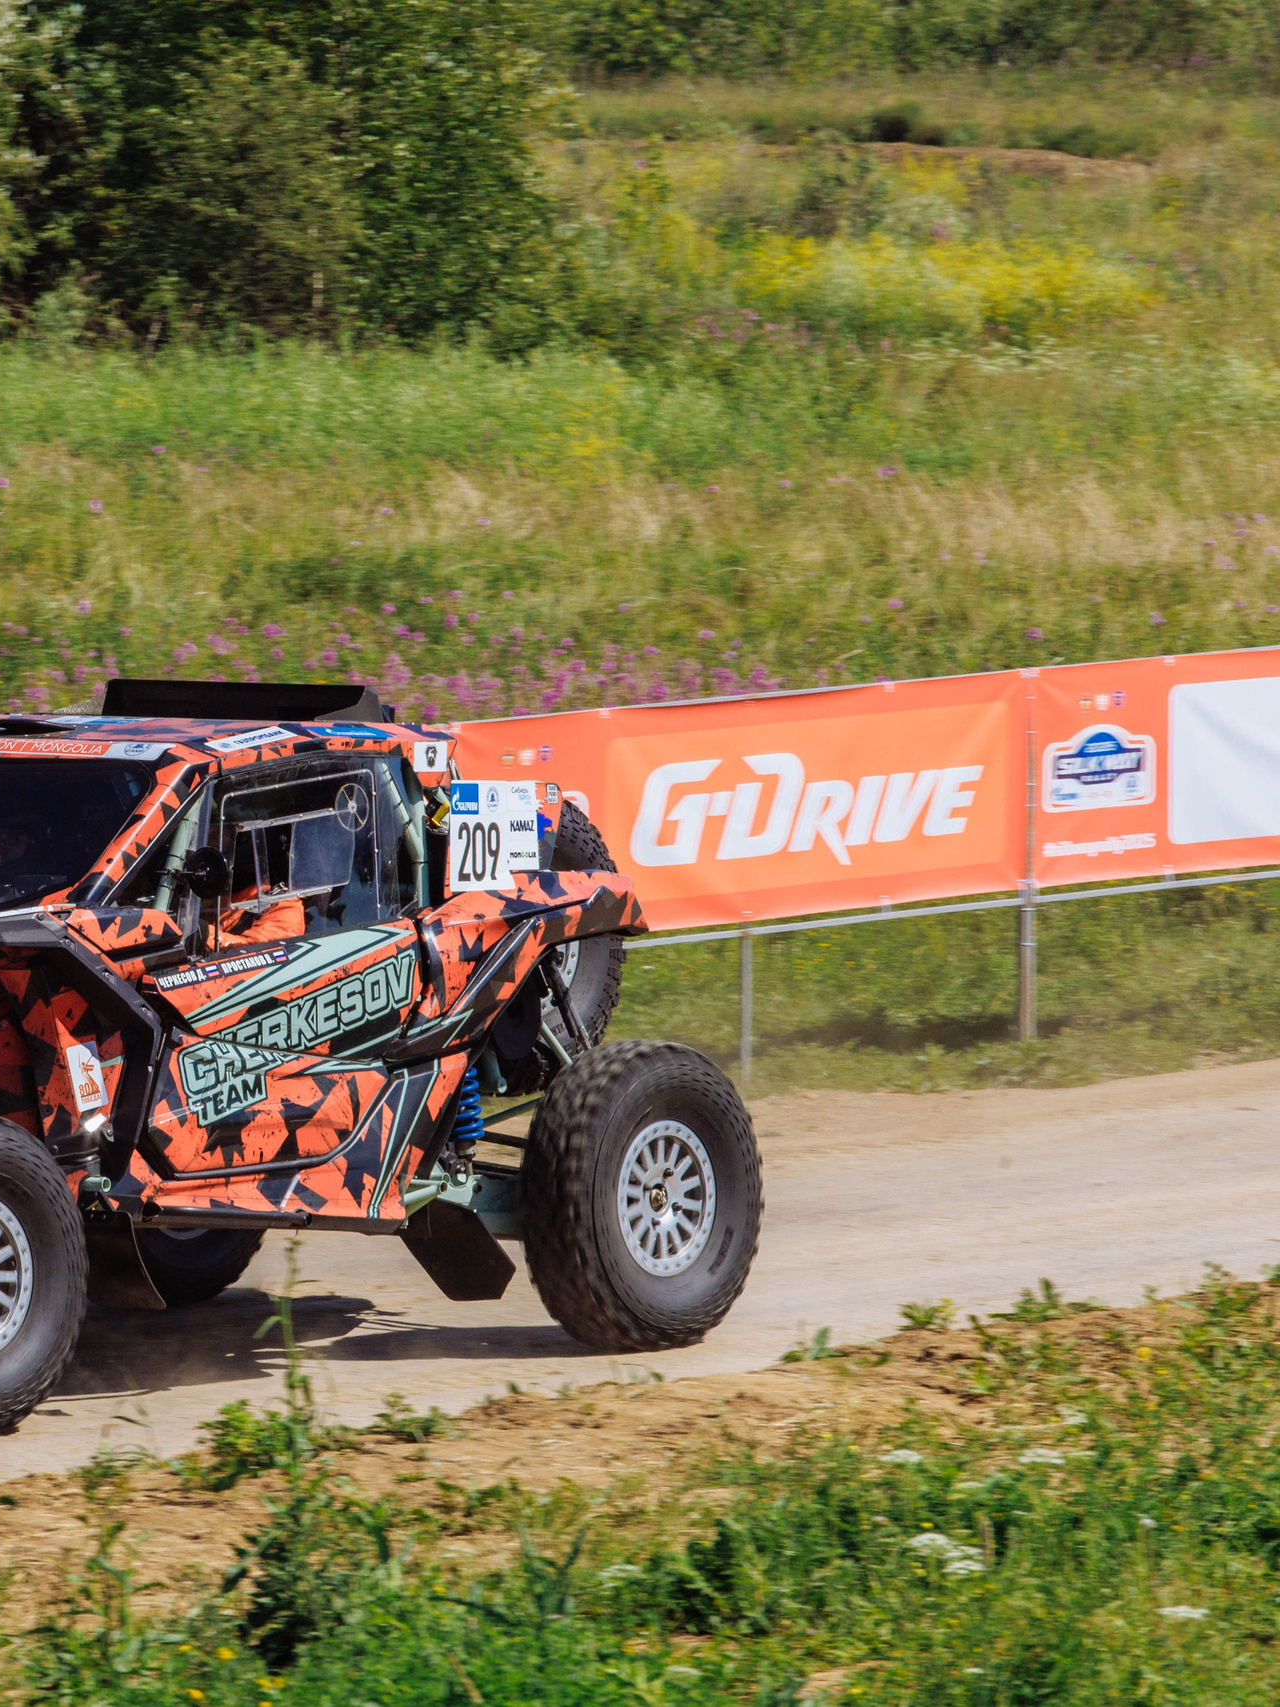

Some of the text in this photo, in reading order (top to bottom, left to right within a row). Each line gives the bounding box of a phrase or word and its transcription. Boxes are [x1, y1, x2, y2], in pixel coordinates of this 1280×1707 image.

[30, 740, 103, 754] MONGOLIA
[510, 820, 535, 832] KAMAZ
[458, 821, 501, 882] 209
[220, 955, 267, 974] ПРОСТАКОВ
[158, 971, 197, 989] ЧЕРКЕСОВ
[178, 950, 416, 1096] CHERKESOV
[78, 1083, 92, 1097] 80
[192, 1076, 264, 1122] TEAM
